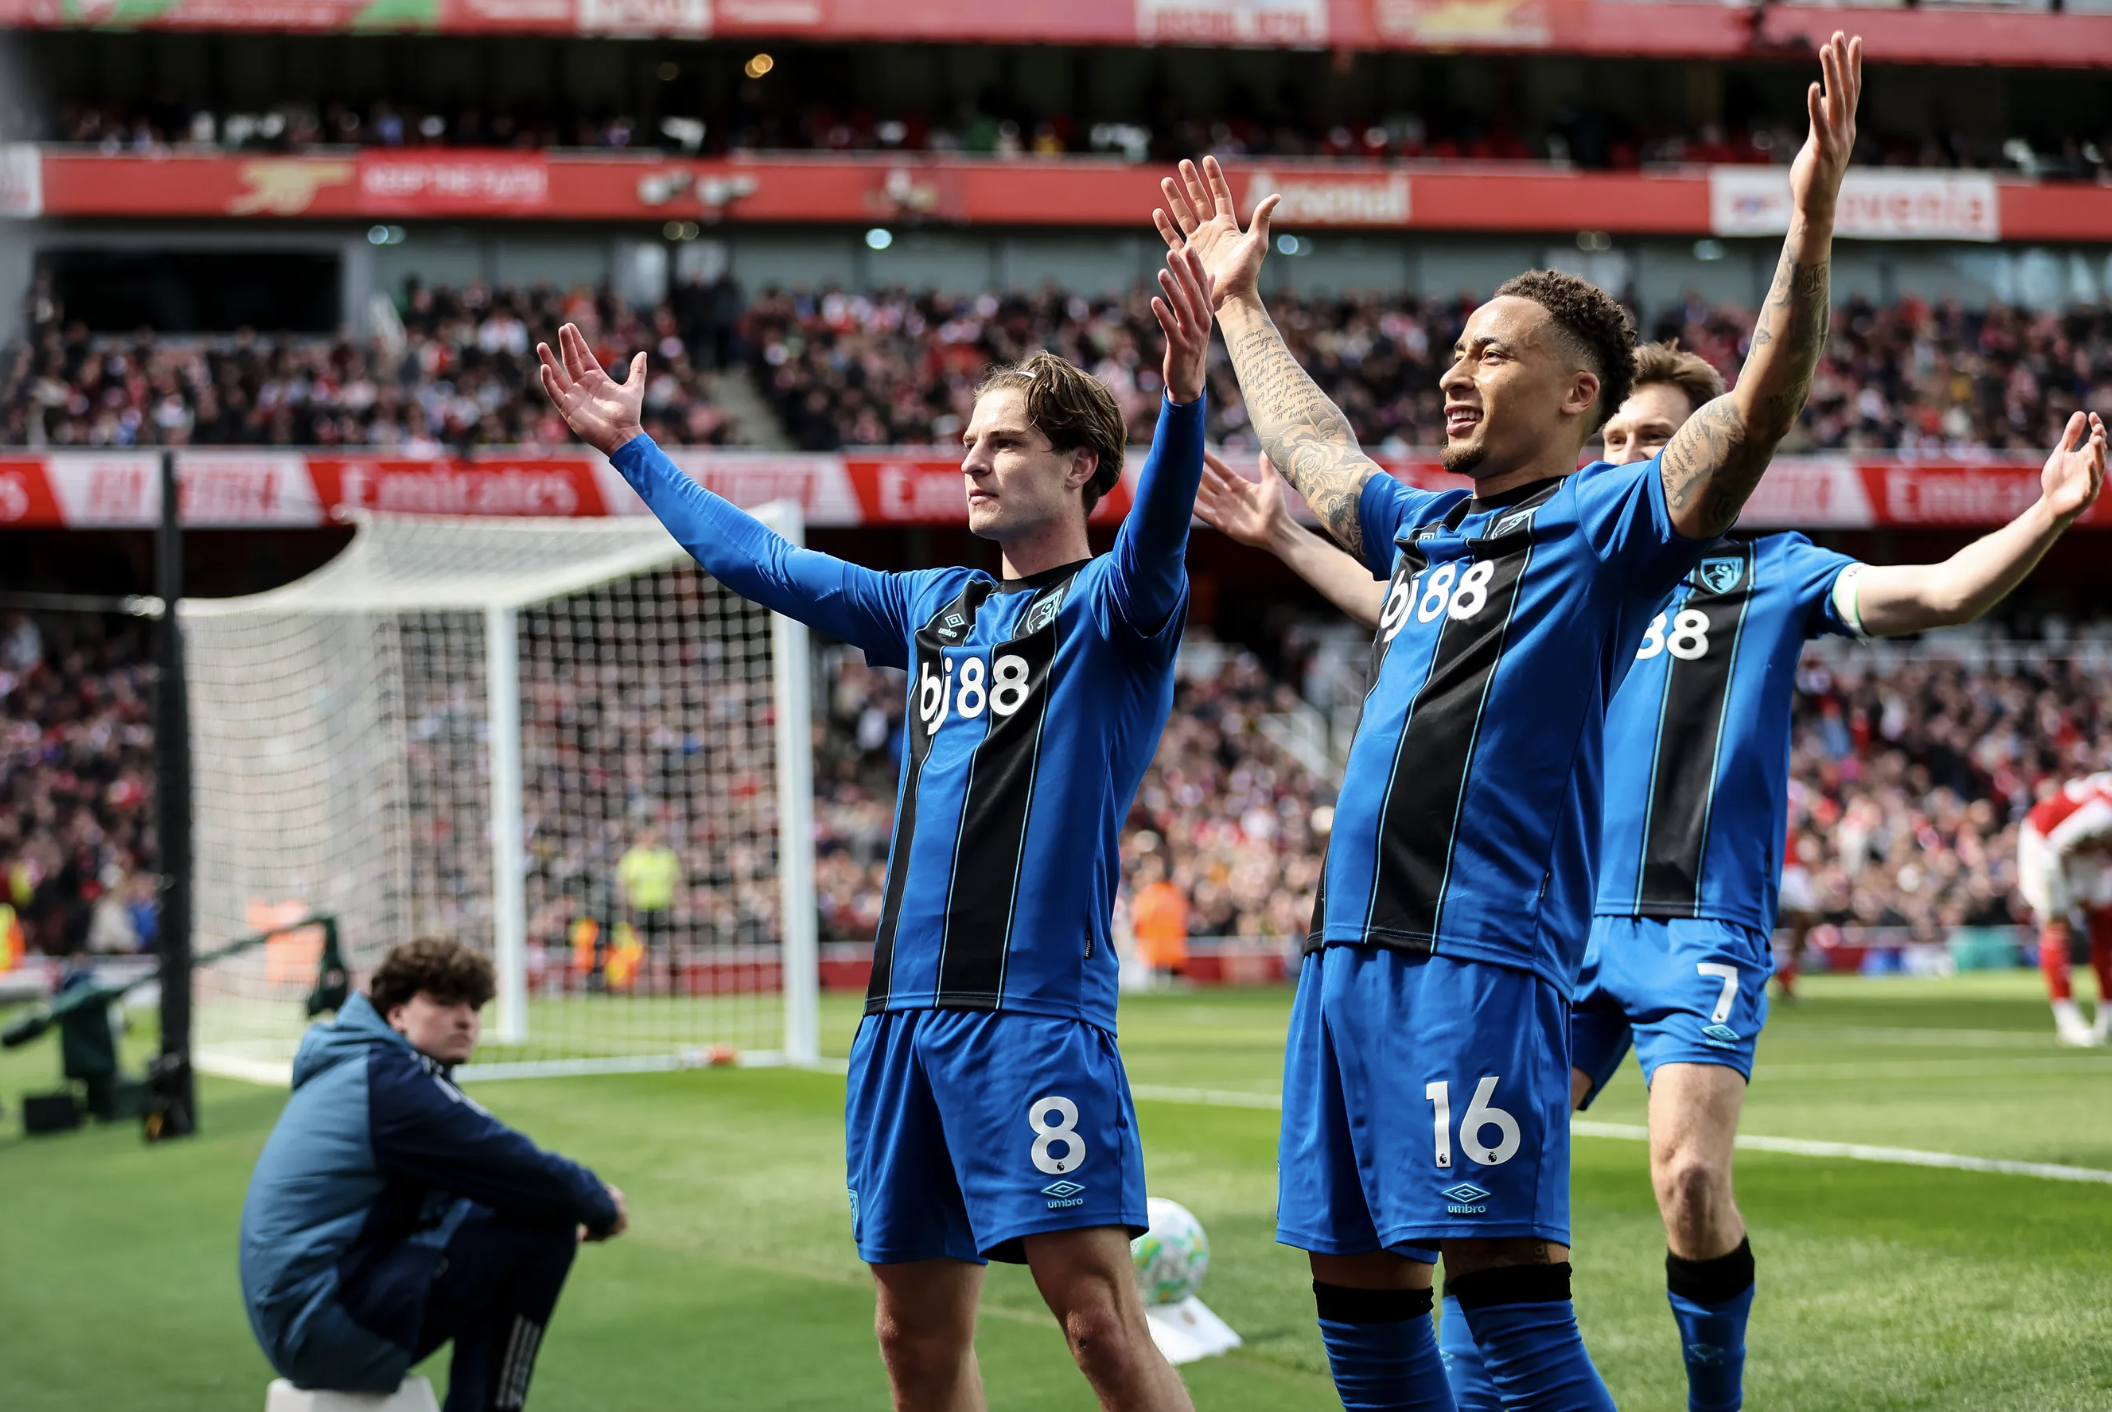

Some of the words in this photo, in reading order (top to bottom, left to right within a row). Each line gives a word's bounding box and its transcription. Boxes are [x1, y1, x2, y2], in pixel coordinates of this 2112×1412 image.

[1242, 169, 1412, 225] Arsenal
[1380, 560, 1494, 643] bj88
[1635, 608, 1711, 661] 88
[920, 654, 1029, 735] bj88
[1696, 962, 1739, 1024] 7
[1028, 1095, 1087, 1175] 8
[1425, 1076, 1521, 1168] 16
[1047, 1197, 1084, 1209] umbro
[1447, 1203, 1487, 1214] umbro
